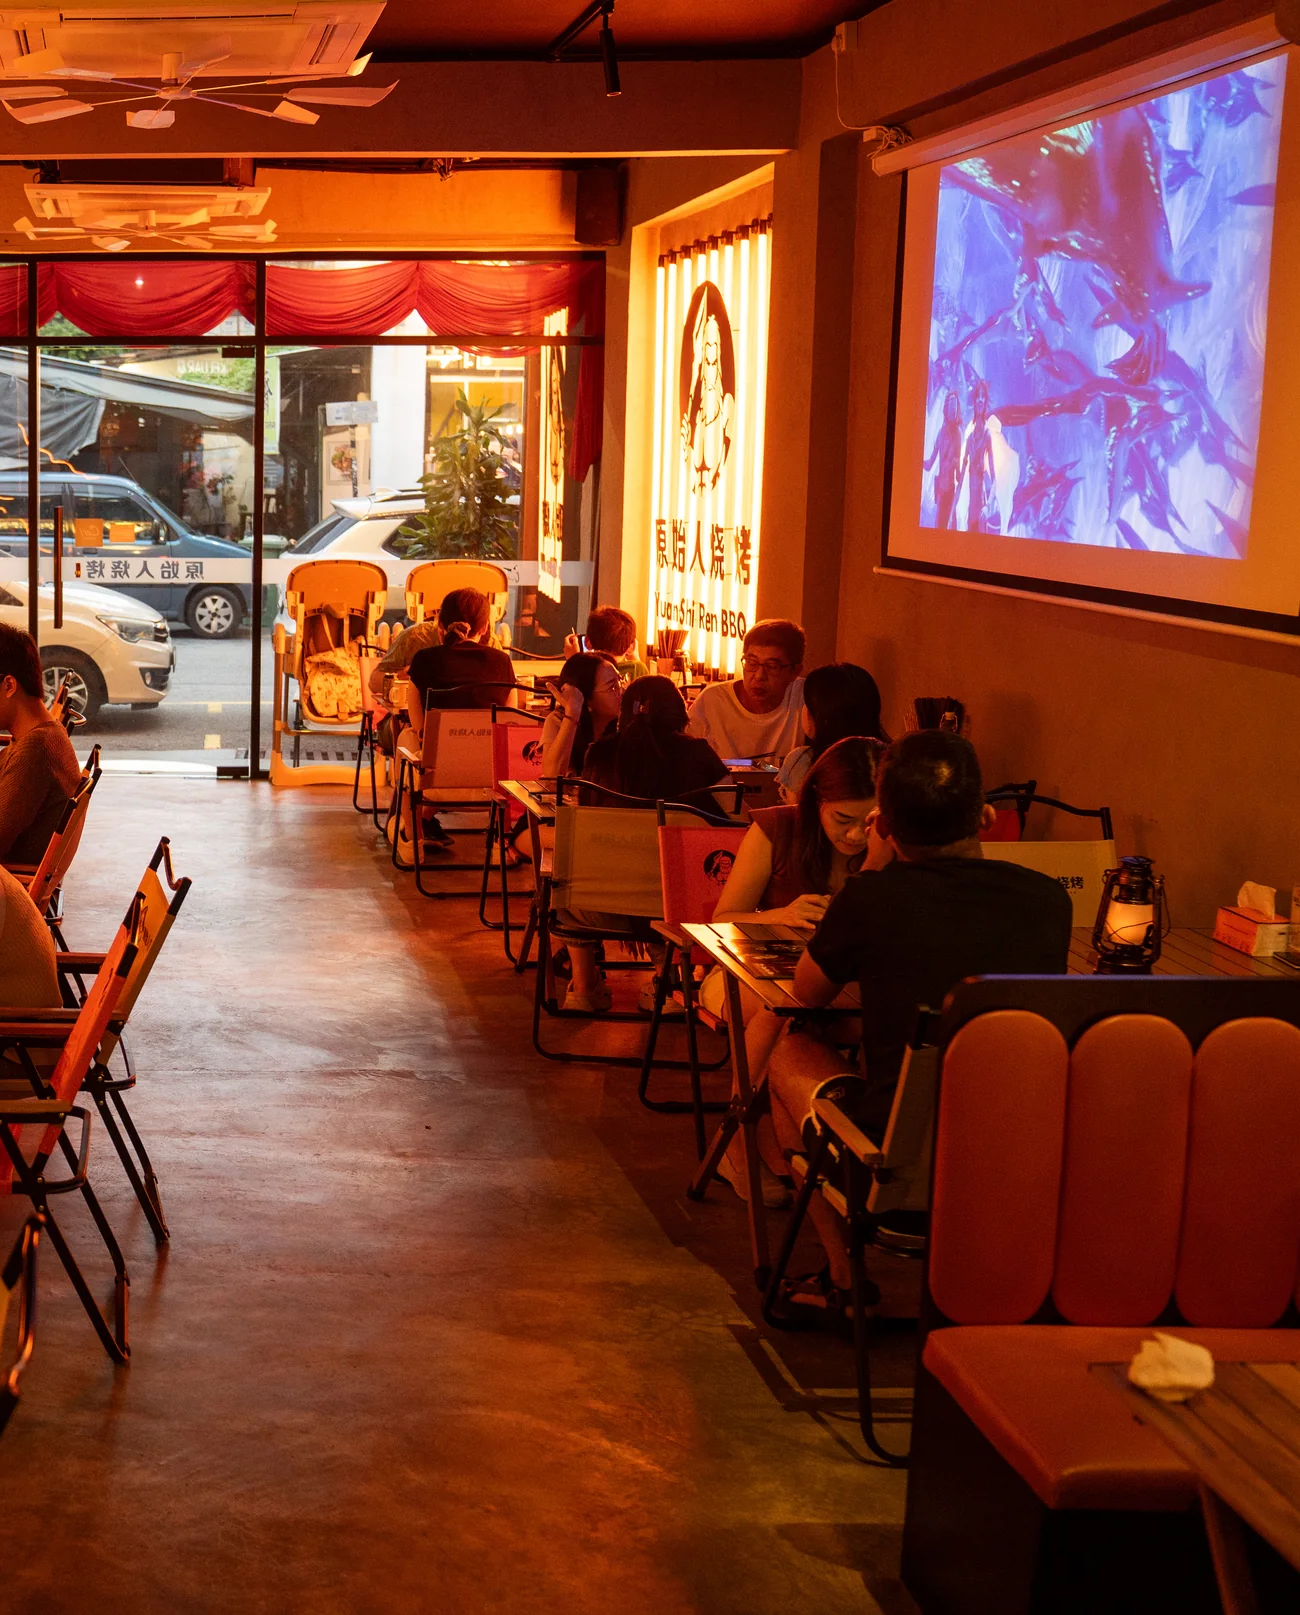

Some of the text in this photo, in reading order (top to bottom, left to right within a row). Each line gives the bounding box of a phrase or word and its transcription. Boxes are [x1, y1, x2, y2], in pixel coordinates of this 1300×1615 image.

[655, 518, 751, 585] 原始人烧烤
[699, 602, 718, 632] Ren
[721, 609, 747, 641] BBQ
